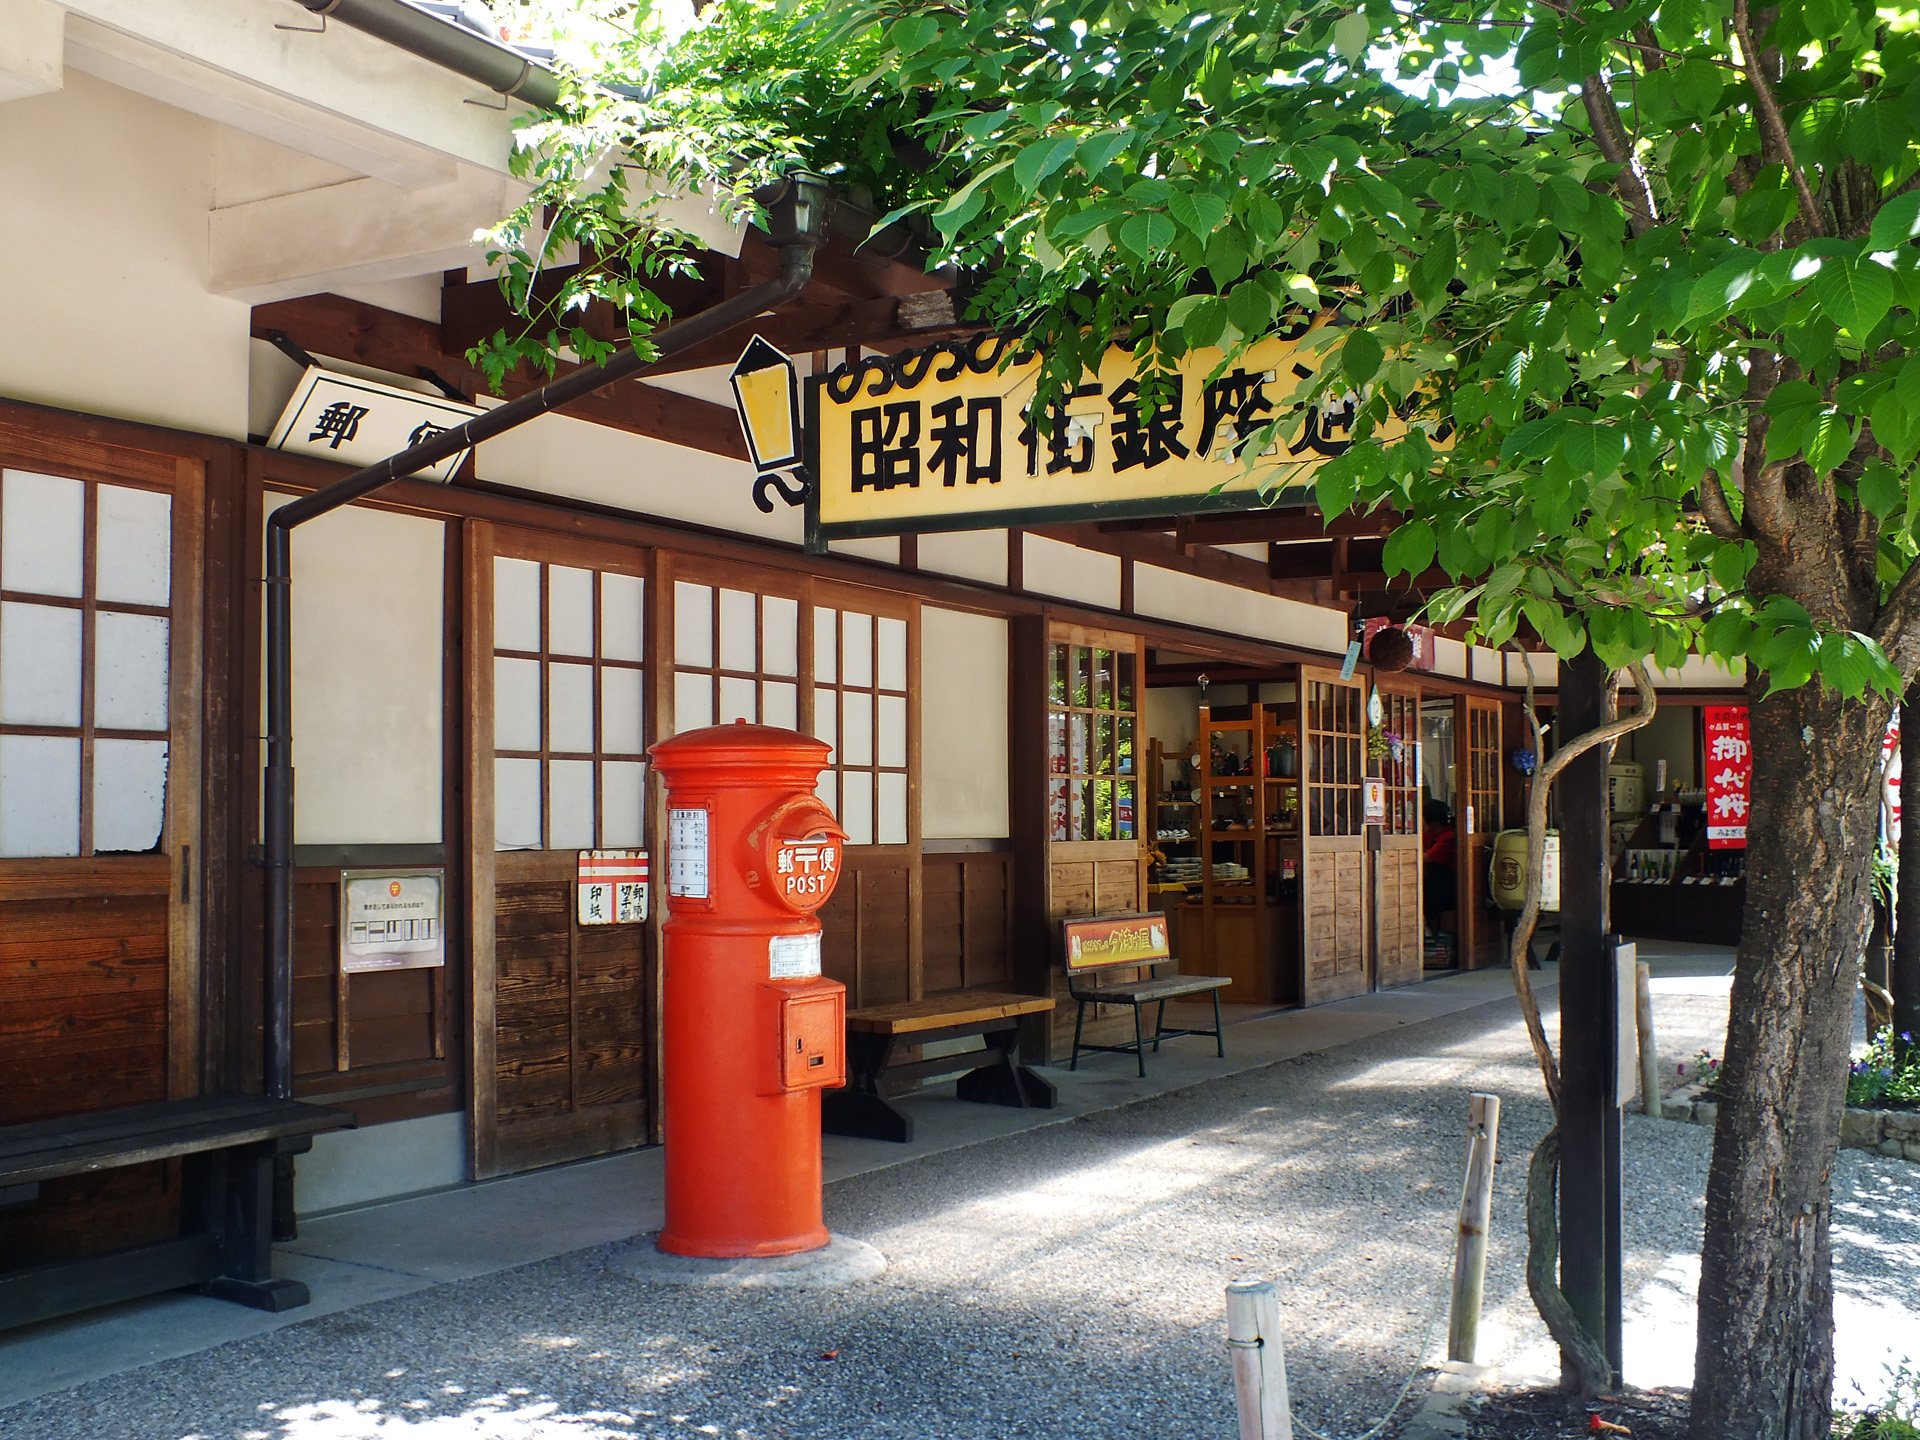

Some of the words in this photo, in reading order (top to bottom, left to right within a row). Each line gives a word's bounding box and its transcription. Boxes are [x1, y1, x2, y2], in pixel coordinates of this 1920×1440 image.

[850, 362, 1456, 494] 昭和街銀座通
[1712, 735, 1749, 819] 御代桜
[590, 885, 602, 919] 印紙
[786, 875, 826, 894] POST
